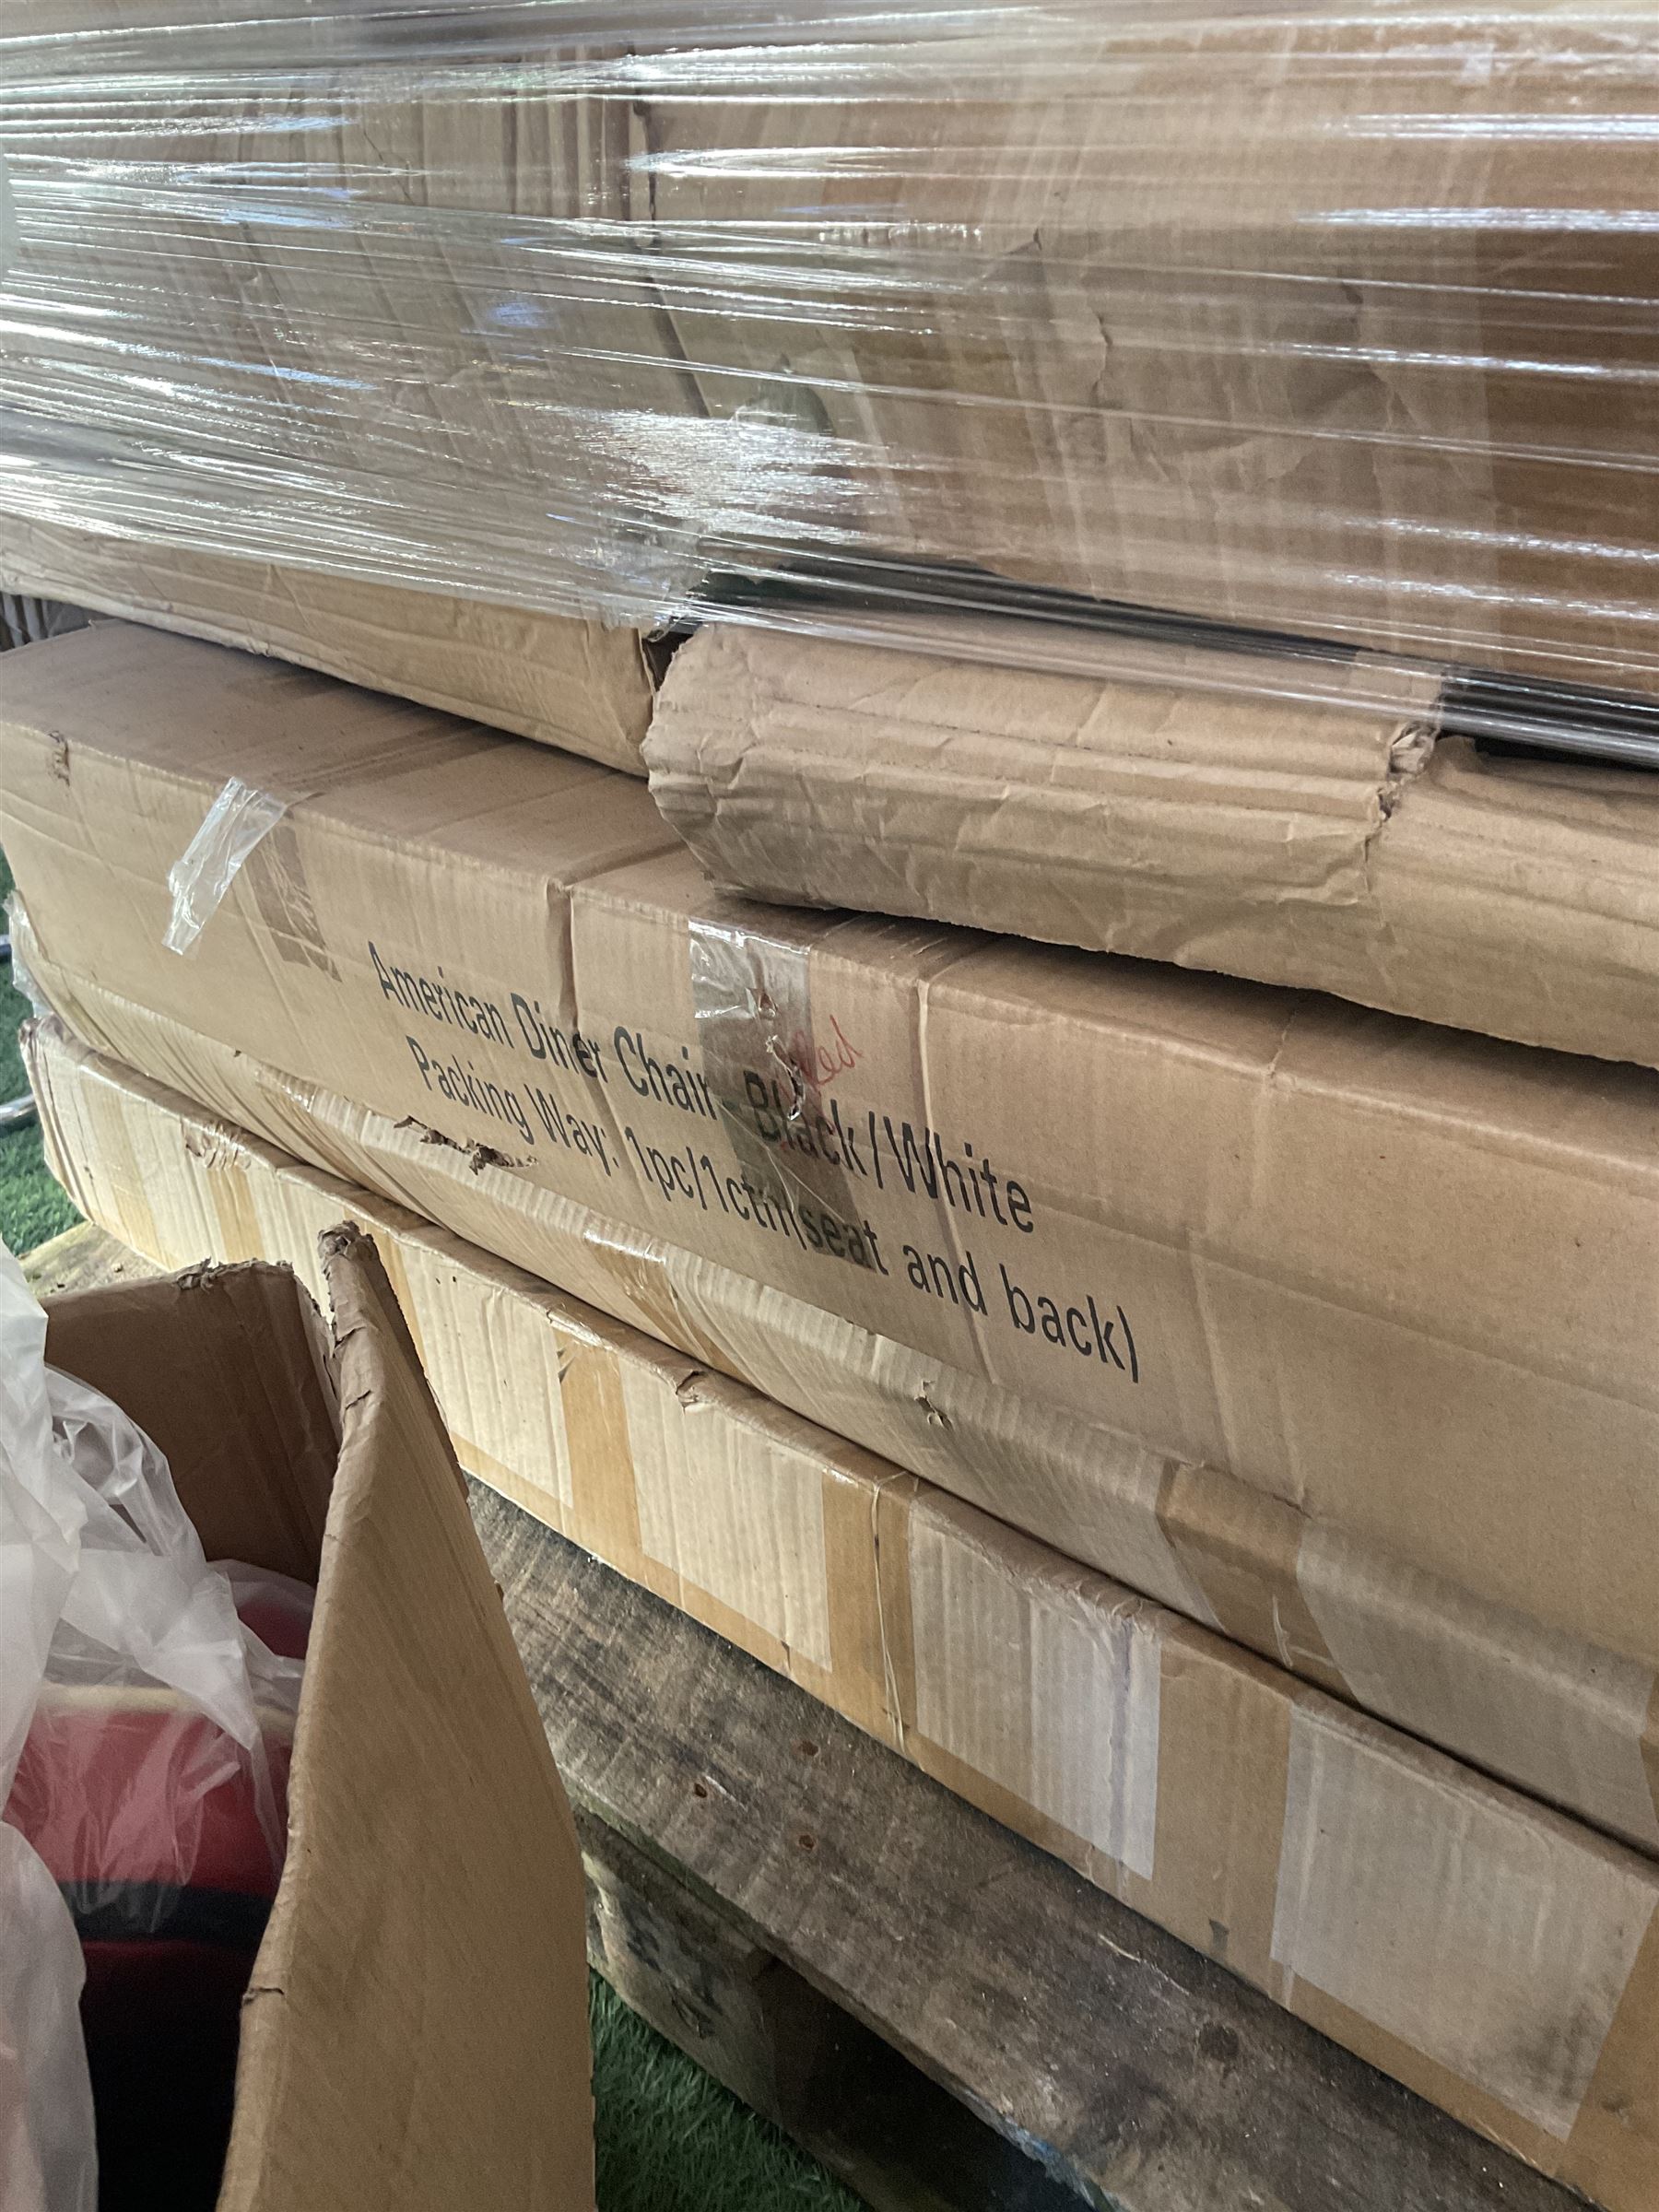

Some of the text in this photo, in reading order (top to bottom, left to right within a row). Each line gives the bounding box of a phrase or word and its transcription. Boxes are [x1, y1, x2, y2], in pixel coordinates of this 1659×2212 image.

[369, 941, 513, 1049] American
[512, 993, 608, 1084] Diner
[614, 1026, 718, 1120] Chair
[406, 1035, 535, 1145] Packing
[524, 1083, 619, 1177] Way:
[902, 1244, 988, 1315] and
[999, 1263, 1139, 1382] back)
